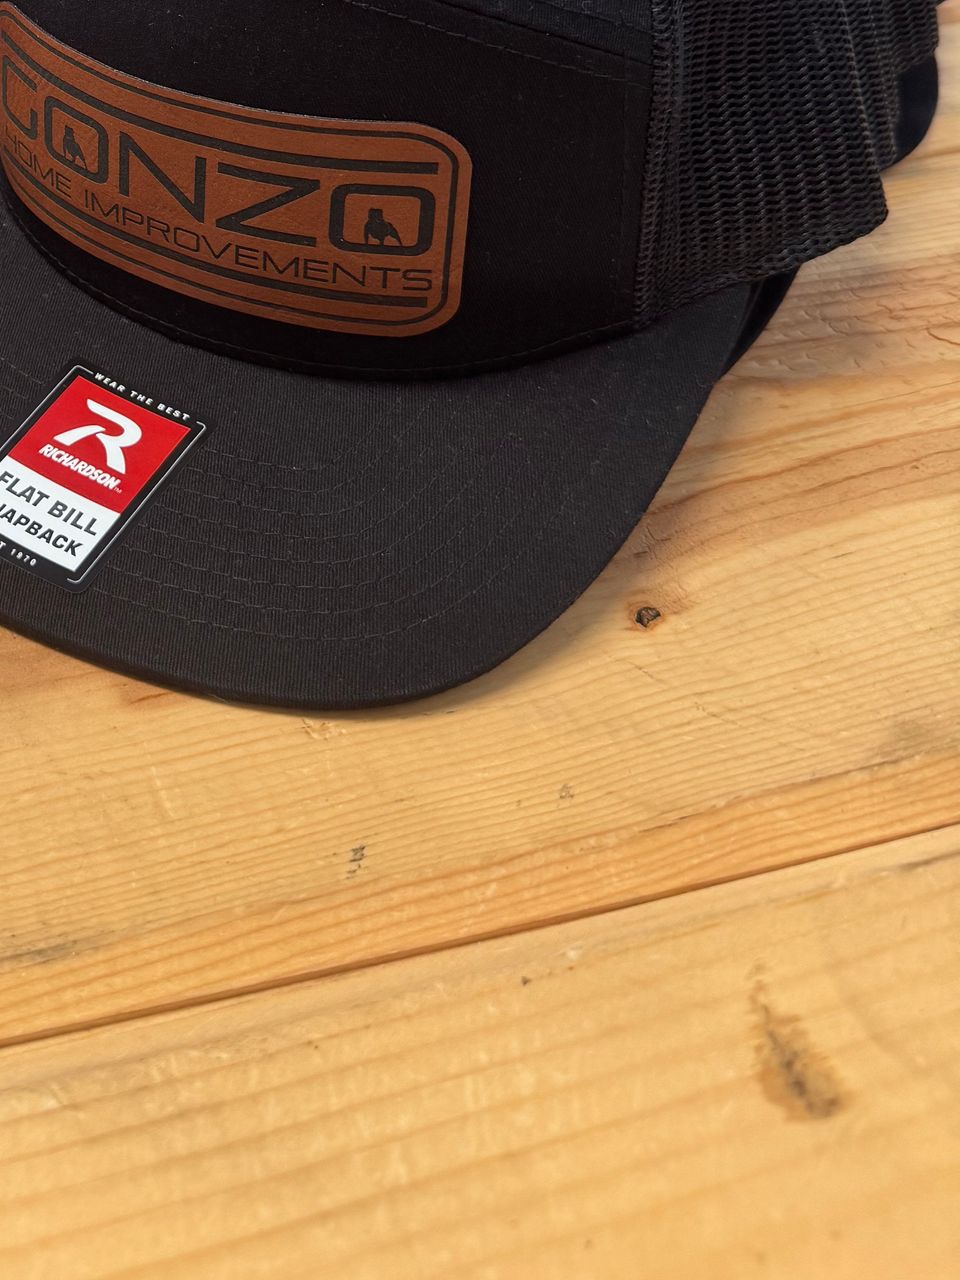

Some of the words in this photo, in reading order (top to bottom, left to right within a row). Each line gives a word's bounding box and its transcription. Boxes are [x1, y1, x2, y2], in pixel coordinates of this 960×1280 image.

[1, 54, 437, 257] GONZO
[5, 123, 72, 199] HOME
[84, 189, 434, 292] IMPROVEMENTS
[94, 372, 126, 393] WEAR
[130, 390, 153, 406] THE
[157, 403, 191, 421] BEST
[38, 443, 122, 491] RICHARDSON
[47, 500, 98, 536] BILL
[10, 548, 37, 567] 1970
